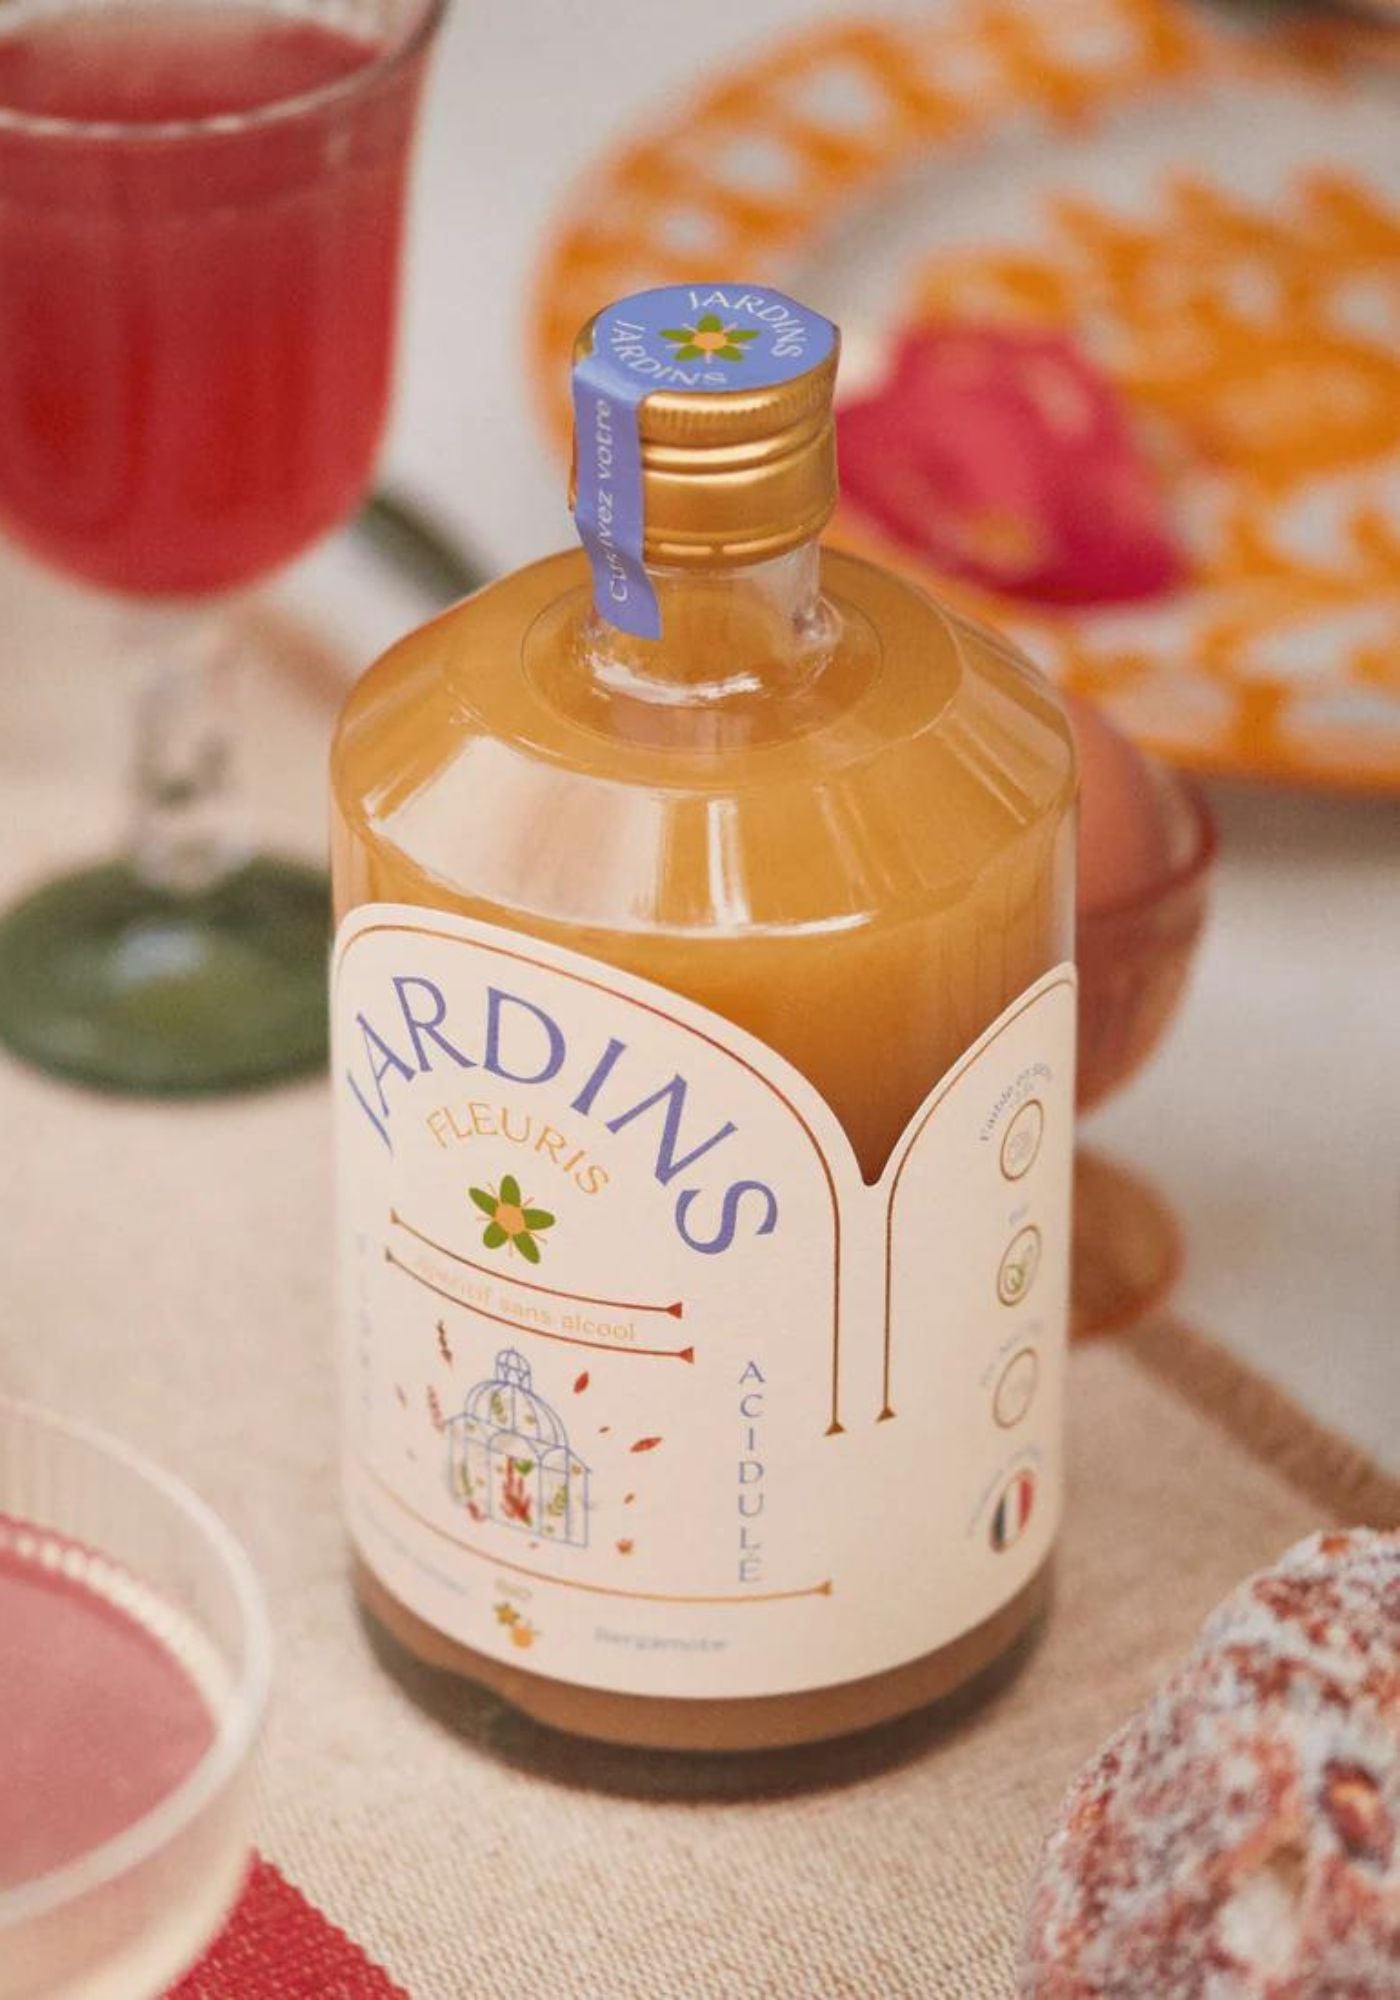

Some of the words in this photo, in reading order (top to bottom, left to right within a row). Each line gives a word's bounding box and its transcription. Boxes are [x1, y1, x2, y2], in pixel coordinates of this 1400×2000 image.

[610, 318, 729, 386] JARDINS
[688, 290, 807, 358] JARDINS
[595, 398, 614, 480] votre
[598, 490, 629, 602] Cuivez
[346, 975, 778, 1256] JARDINS
[426, 1102, 610, 1195] FLEURIS
[561, 1312, 636, 1342] alcool
